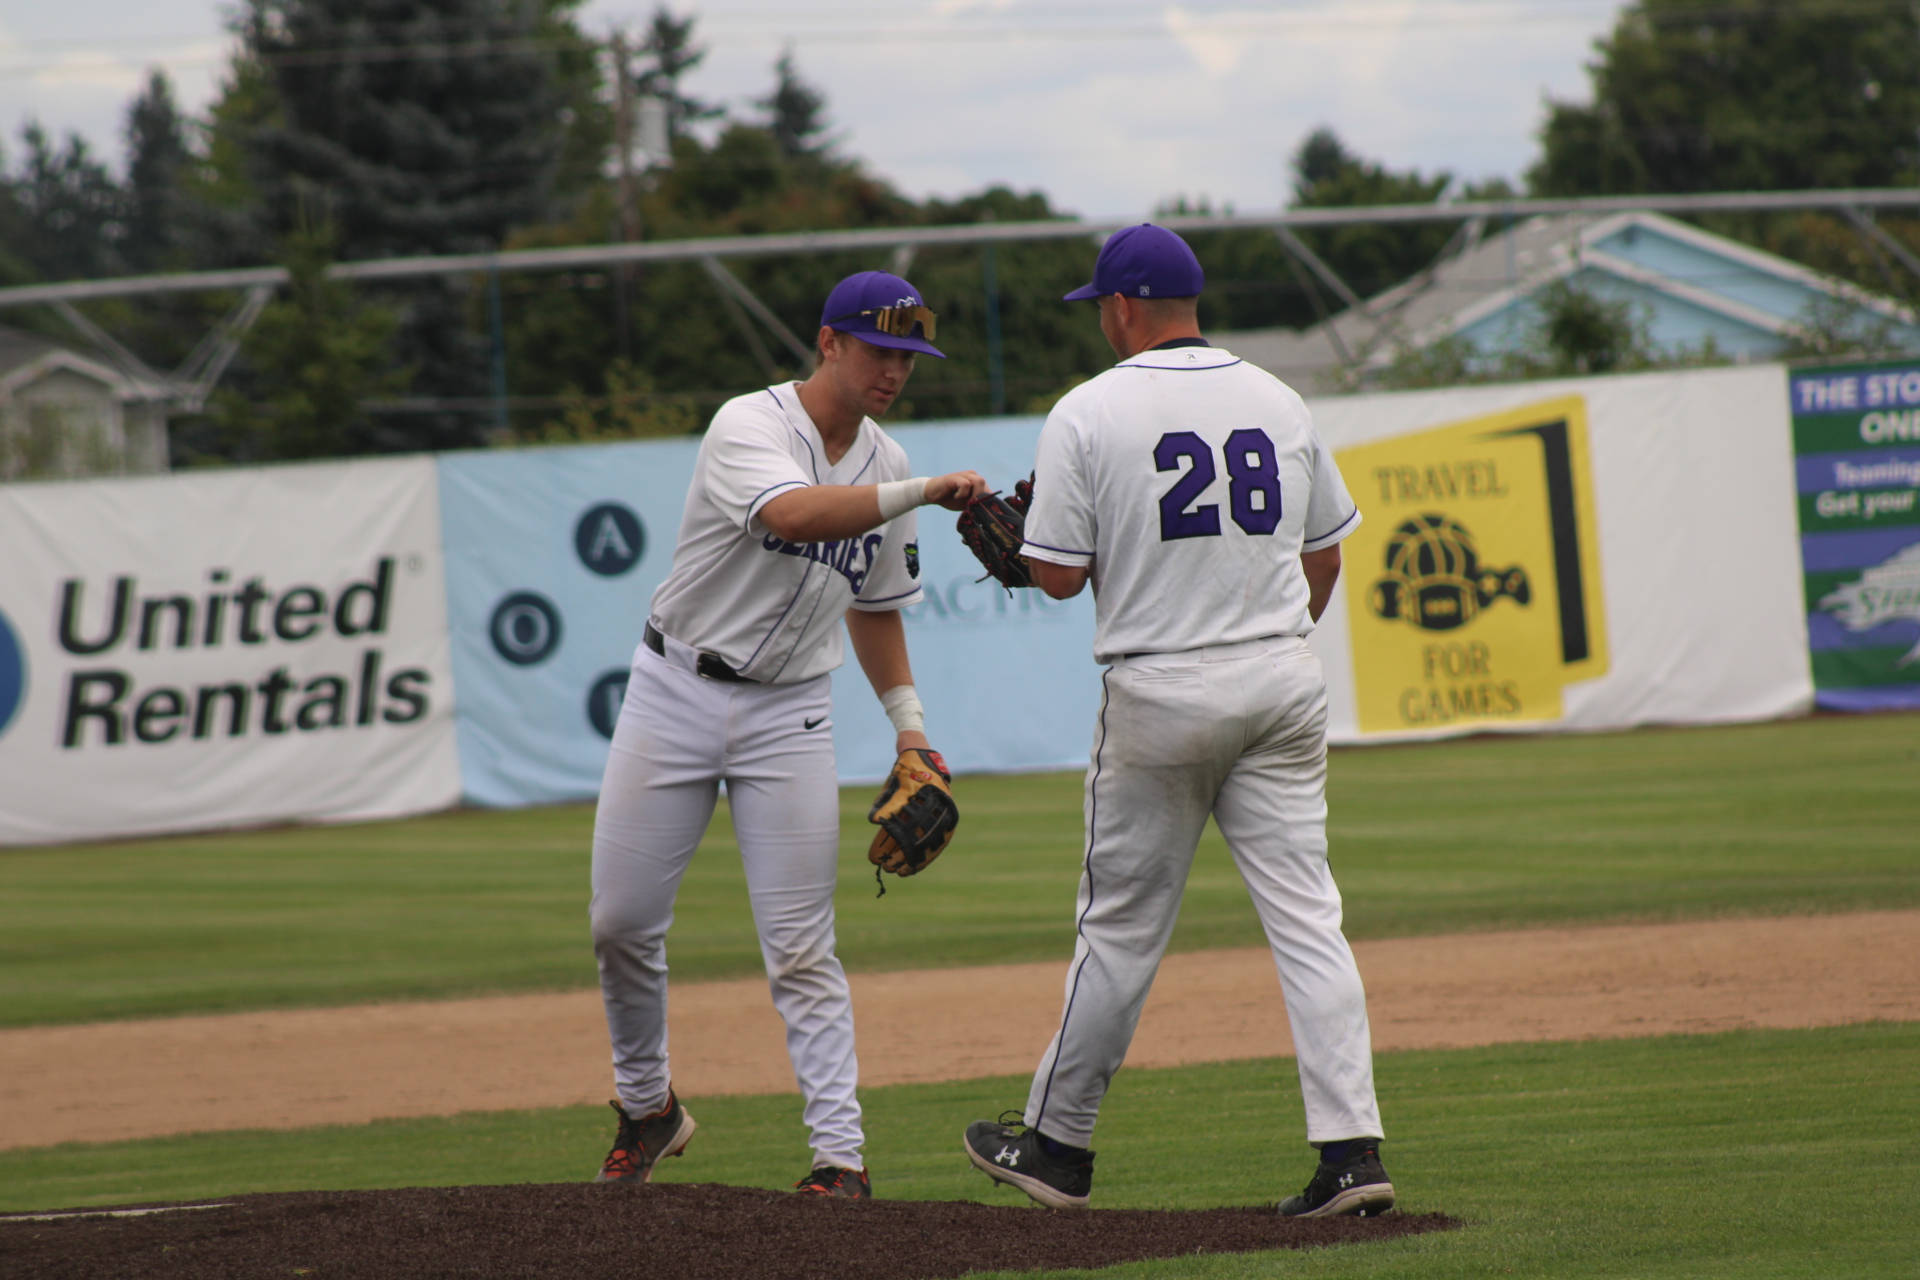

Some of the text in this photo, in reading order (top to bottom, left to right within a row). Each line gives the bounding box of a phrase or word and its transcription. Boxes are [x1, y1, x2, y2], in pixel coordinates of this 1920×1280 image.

[1797, 376, 1859, 411] THE
[1154, 429, 1282, 541] 28
[1371, 458, 1510, 506] TRAVEL
[1816, 491, 1917, 519] Get your
[57, 556, 396, 654] United
[1423, 639, 1490, 682] FOR
[60, 650, 432, 747] Rentals
[1399, 679, 1522, 726] GAMES
